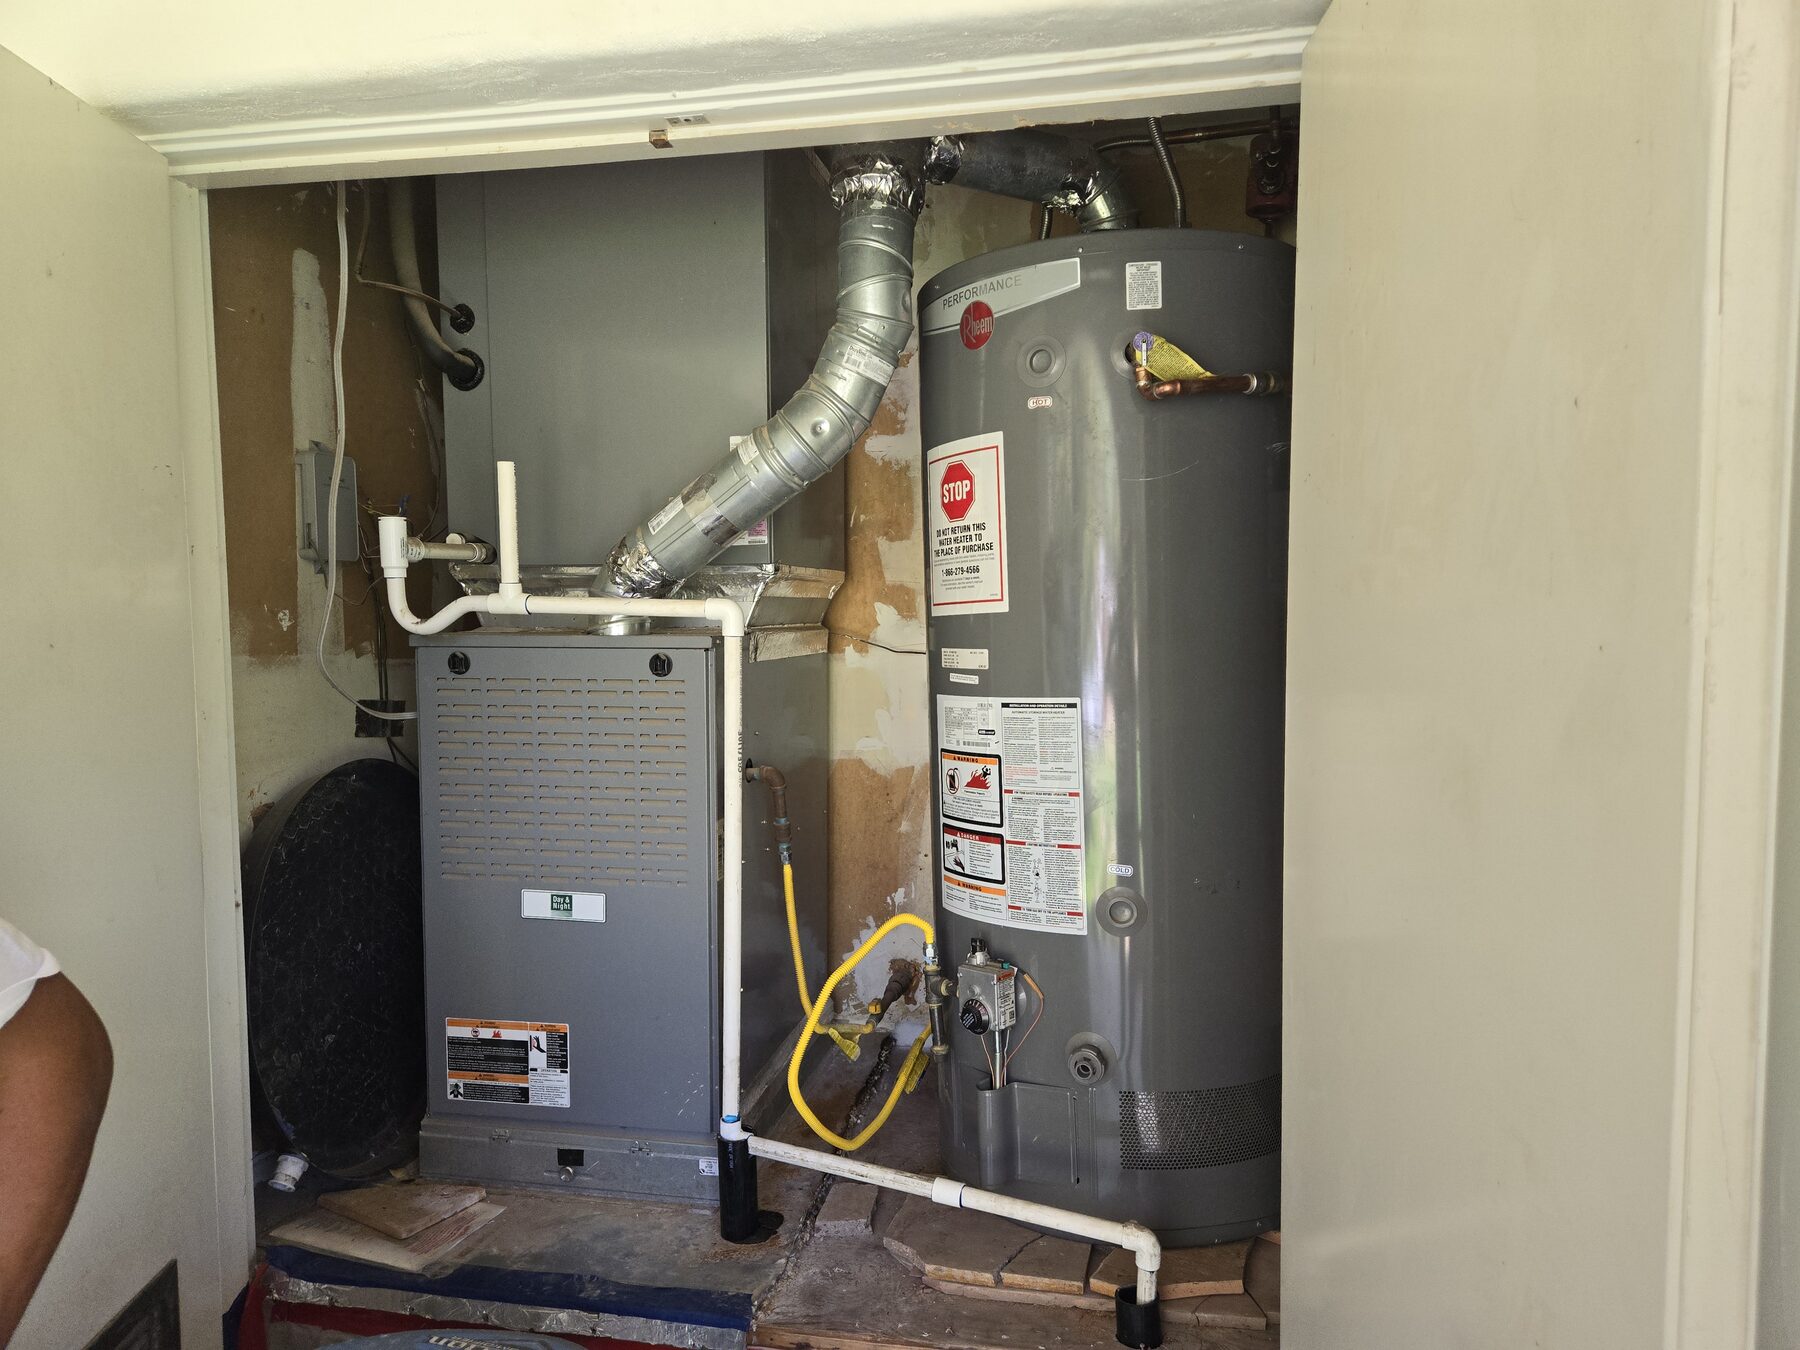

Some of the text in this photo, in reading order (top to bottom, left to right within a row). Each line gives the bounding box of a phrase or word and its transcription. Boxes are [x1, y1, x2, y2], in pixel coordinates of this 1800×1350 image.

[942, 275, 1023, 310] PERFORMANCE
[963, 301, 993, 343] Rheem
[943, 479, 971, 504] STOP
[951, 524, 970, 535] RETURN
[972, 522, 986, 531] THIS
[939, 533, 982, 546] WATER HEATER TO
[940, 547, 954, 556] PLACE
[954, 545, 961, 555] OF
[962, 542, 994, 553] PURCHASE
[957, 756, 979, 764] WARNING
[960, 833, 980, 841] DANGER
[1110, 865, 1130, 874] COLD
[962, 881, 982, 892] WARNING
